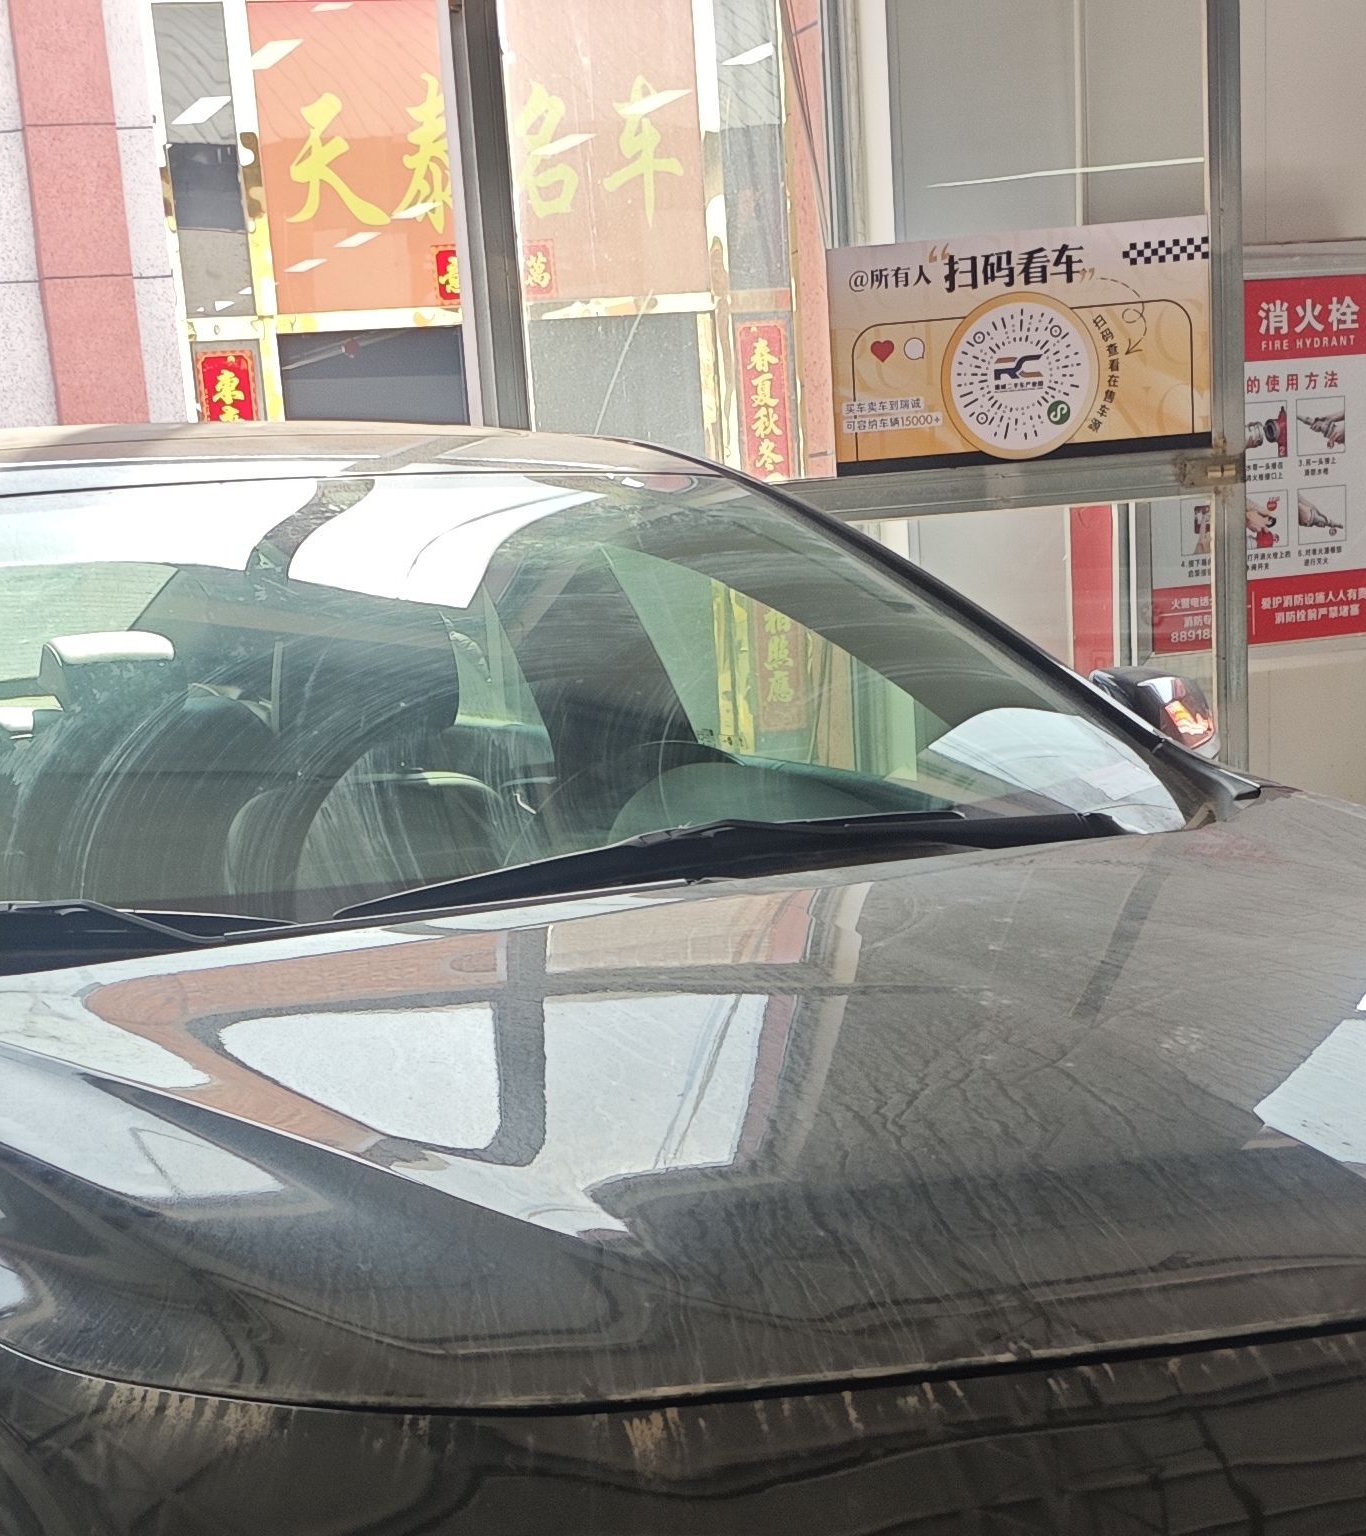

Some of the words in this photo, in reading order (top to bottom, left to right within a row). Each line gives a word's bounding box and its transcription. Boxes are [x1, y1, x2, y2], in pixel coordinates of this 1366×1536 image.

[1258, 296, 1360, 335] 消火栓
[1261, 339, 1289, 351] FIRE
[1296, 335, 1356, 349] HYDRANT
[1246, 371, 1339, 394] 的使用方法
[845, 398, 922, 414] 买车卖车到瑞诚
[846, 414, 941, 431] 可容纳车辆15000+
[1171, 629, 1212, 643] 88918
